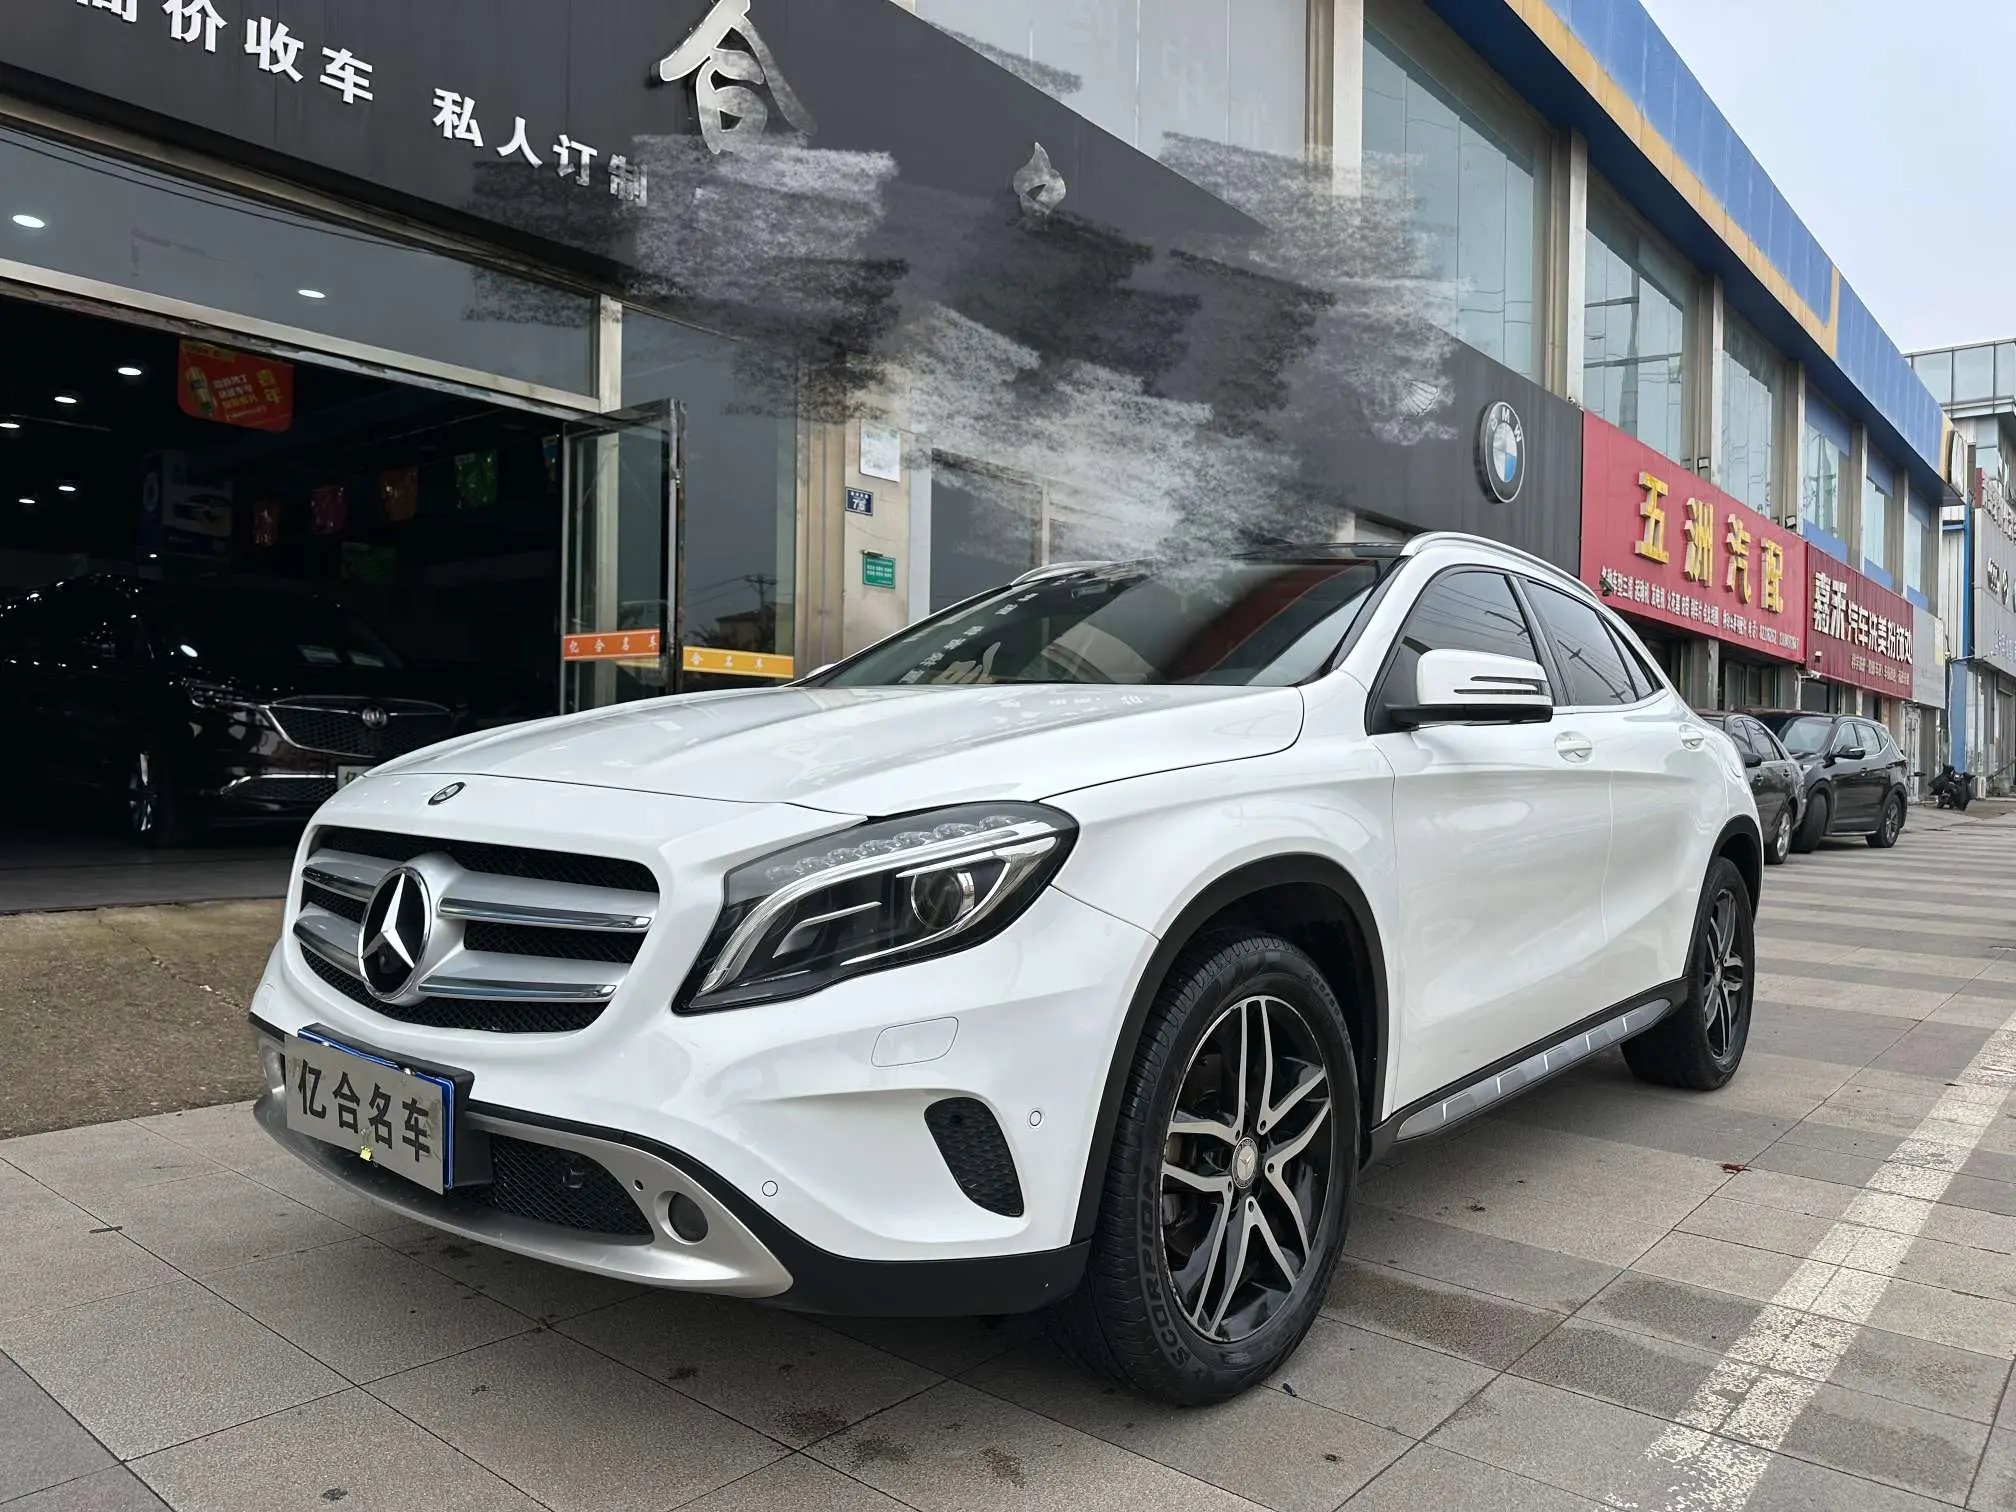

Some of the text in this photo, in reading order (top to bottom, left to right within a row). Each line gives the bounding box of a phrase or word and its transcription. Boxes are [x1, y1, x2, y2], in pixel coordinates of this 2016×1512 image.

[432, 88, 648, 207] 私人订制
[1490, 405, 1522, 442] BMW
[1635, 471, 1784, 613] 五洲汽配
[298, 1058, 431, 1163] 亿合名车
[1140, 1164, 1192, 1370] SCORPION
